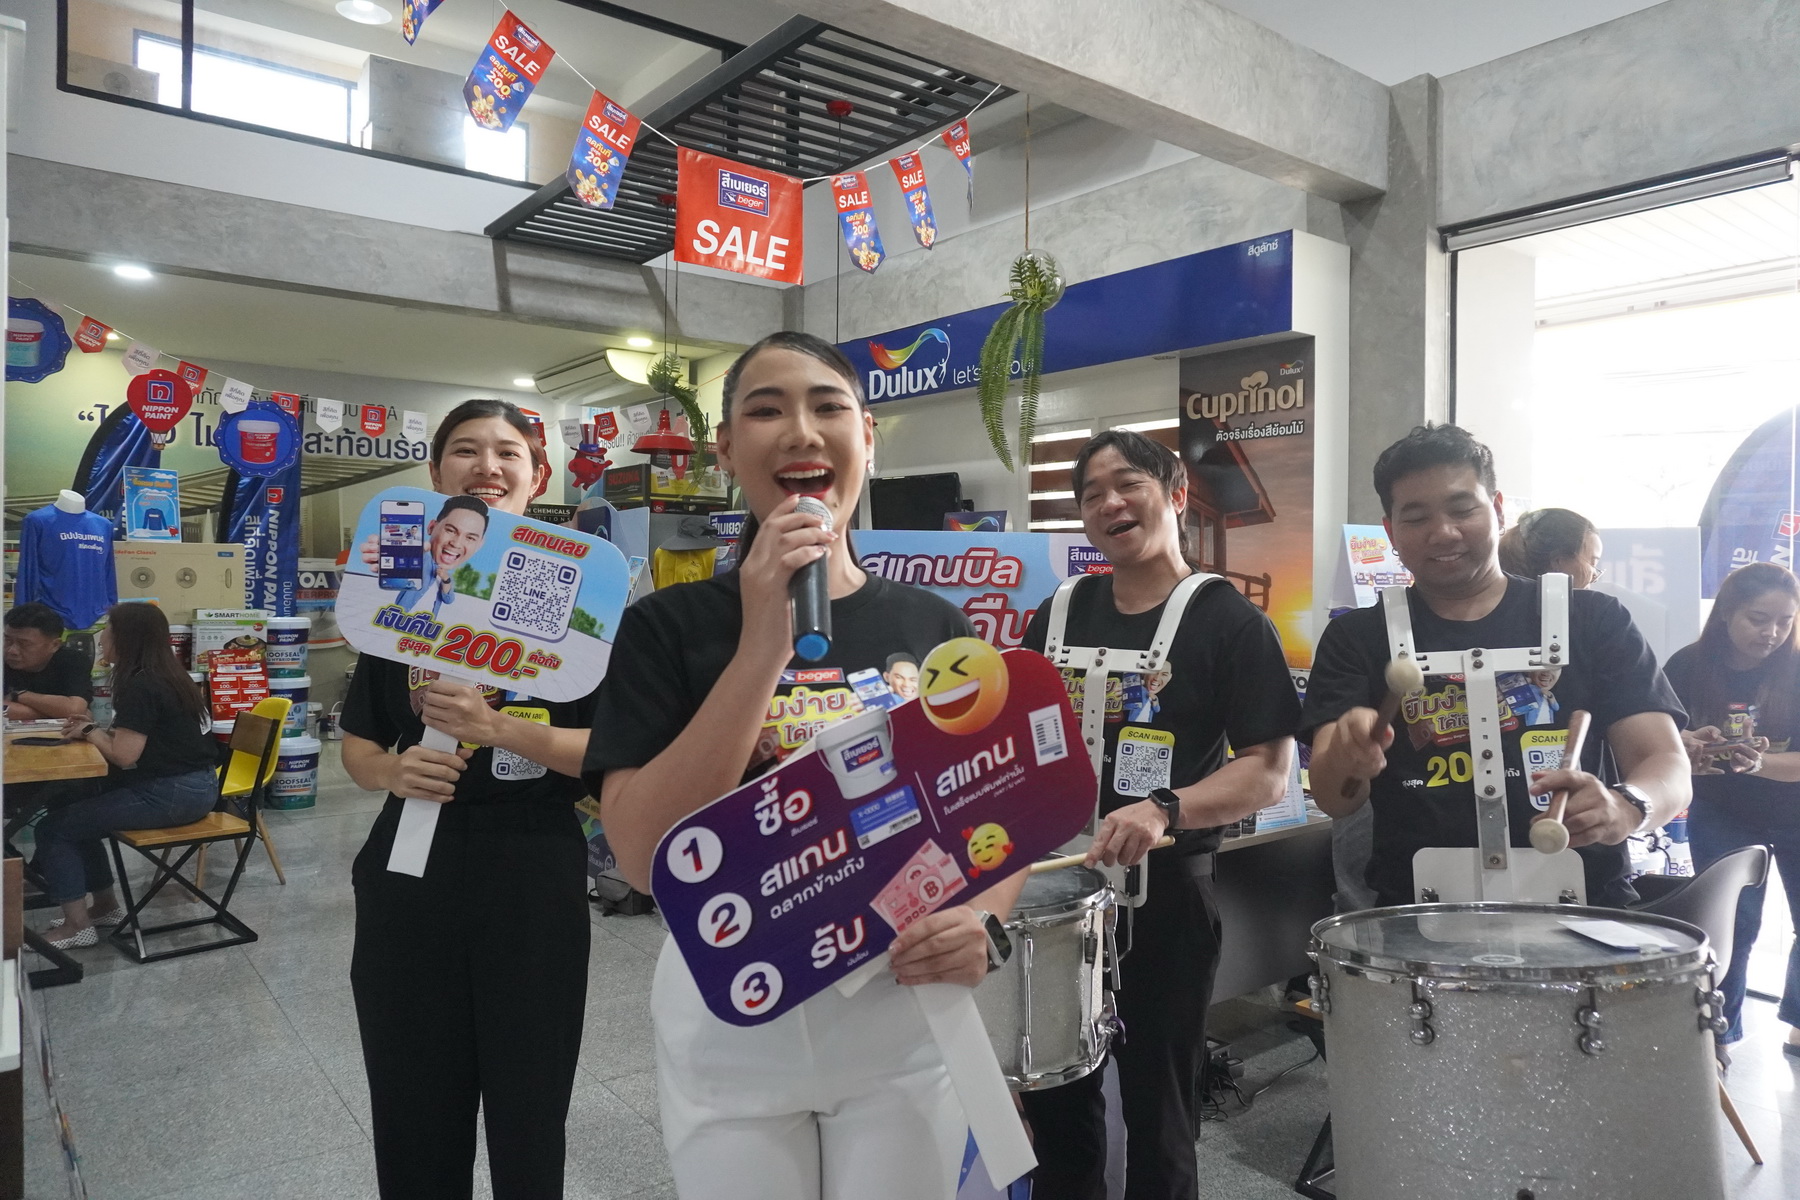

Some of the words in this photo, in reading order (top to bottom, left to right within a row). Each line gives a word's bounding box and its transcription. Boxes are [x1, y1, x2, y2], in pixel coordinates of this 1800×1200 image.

[495, 35, 540, 76] SALE
[489, 55, 518, 82] ลดทันที
[589, 115, 631, 150] SALE
[585, 136, 612, 158] ลดทันที
[721, 172, 768, 198] สีเบเยอร์
[902, 169, 923, 189] SALE
[737, 195, 763, 208] beger
[839, 191, 868, 208] SALE
[692, 219, 790, 271] SALE
[1247, 239, 1279, 257] สีดูลักซ์
[868, 365, 939, 400] Dulux
[1280, 367, 1302, 376] Dulux
[141, 404, 179, 414] NIPPON
[144, 412, 173, 420] PAINT
[1215, 421, 1304, 442] ตัวจริงเรื่องสีย้อมไม้
[608, 471, 640, 486] SUZUKA
[533, 507, 571, 515] CHEMICALS
[265, 508, 281, 580] NIPPON
[511, 527, 590, 558] สแกนเลย
[861, 550, 1018, 585] สแกนบิล
[297, 572, 329, 588] OA
[522, 586, 547, 600] LINE
[375, 607, 442, 640] เงินคืน
[399, 638, 431, 655] สูงสุด
[435, 627, 537, 678] 200.-
[527, 650, 561, 669] ต่อถัง
[797, 669, 838, 682] beger
[507, 710, 531, 718] SCAN
[1127, 731, 1150, 740] SCAN
[1151, 734, 1167, 742] เลย!
[1531, 735, 1558, 743] SCAN
[844, 738, 879, 762] สีเบเยอร์
[936, 736, 1016, 797] สแกน
[754, 776, 811, 836] ซื้อ
[682, 836, 703, 873] 1
[760, 829, 848, 897] สแกน
[770, 856, 865, 920] ฉลากข้างถัง
[710, 902, 741, 944] 2
[810, 916, 864, 969] รับ
[743, 971, 770, 1009] 3
